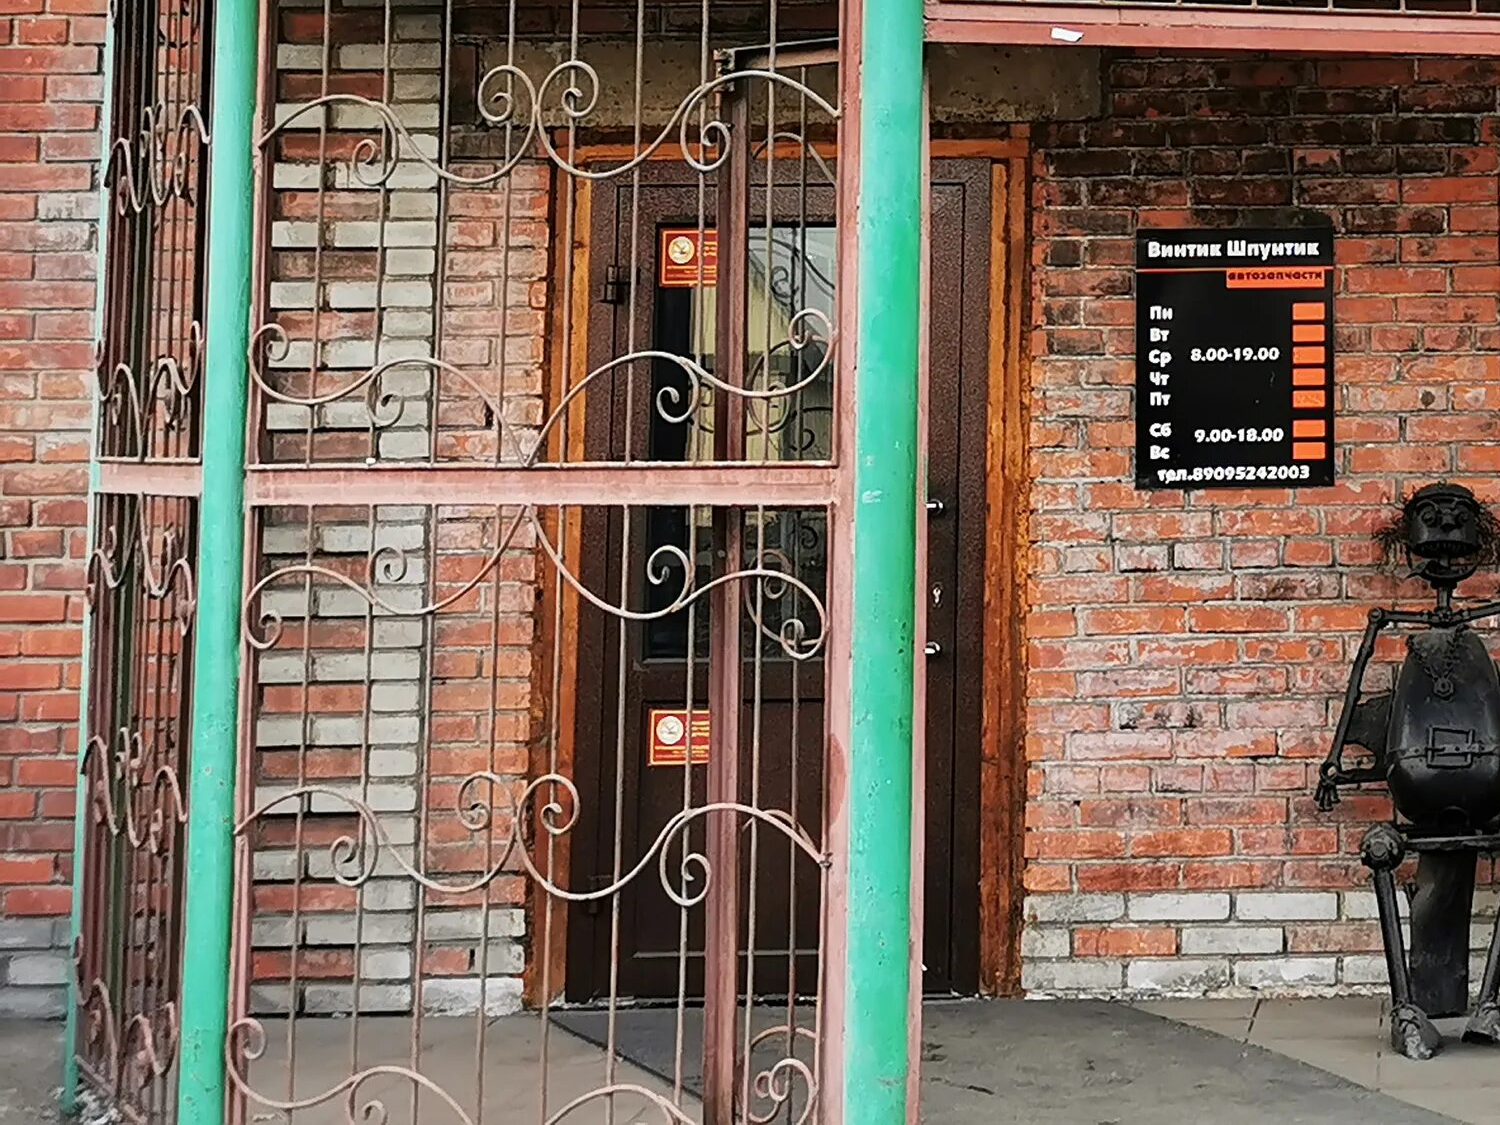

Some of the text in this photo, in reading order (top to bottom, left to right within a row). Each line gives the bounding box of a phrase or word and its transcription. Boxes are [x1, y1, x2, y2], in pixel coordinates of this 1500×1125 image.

[1148, 240, 1320, 261] Винтик Шпунтик
[1228, 271, 1322, 281] автозапчасти
[1150, 306, 1173, 320] Пн
[1150, 328, 1169, 342] Вт
[1149, 349, 1172, 367] Ср
[1190, 347, 1280, 361] 8.00-19.00
[1150, 372, 1169, 386] Чт
[1150, 392, 1171, 406] Пт
[1149, 422, 1172, 437] Сб
[1194, 428, 1284, 443] 9.00-18.00
[1150, 445, 1170, 460] Вс
